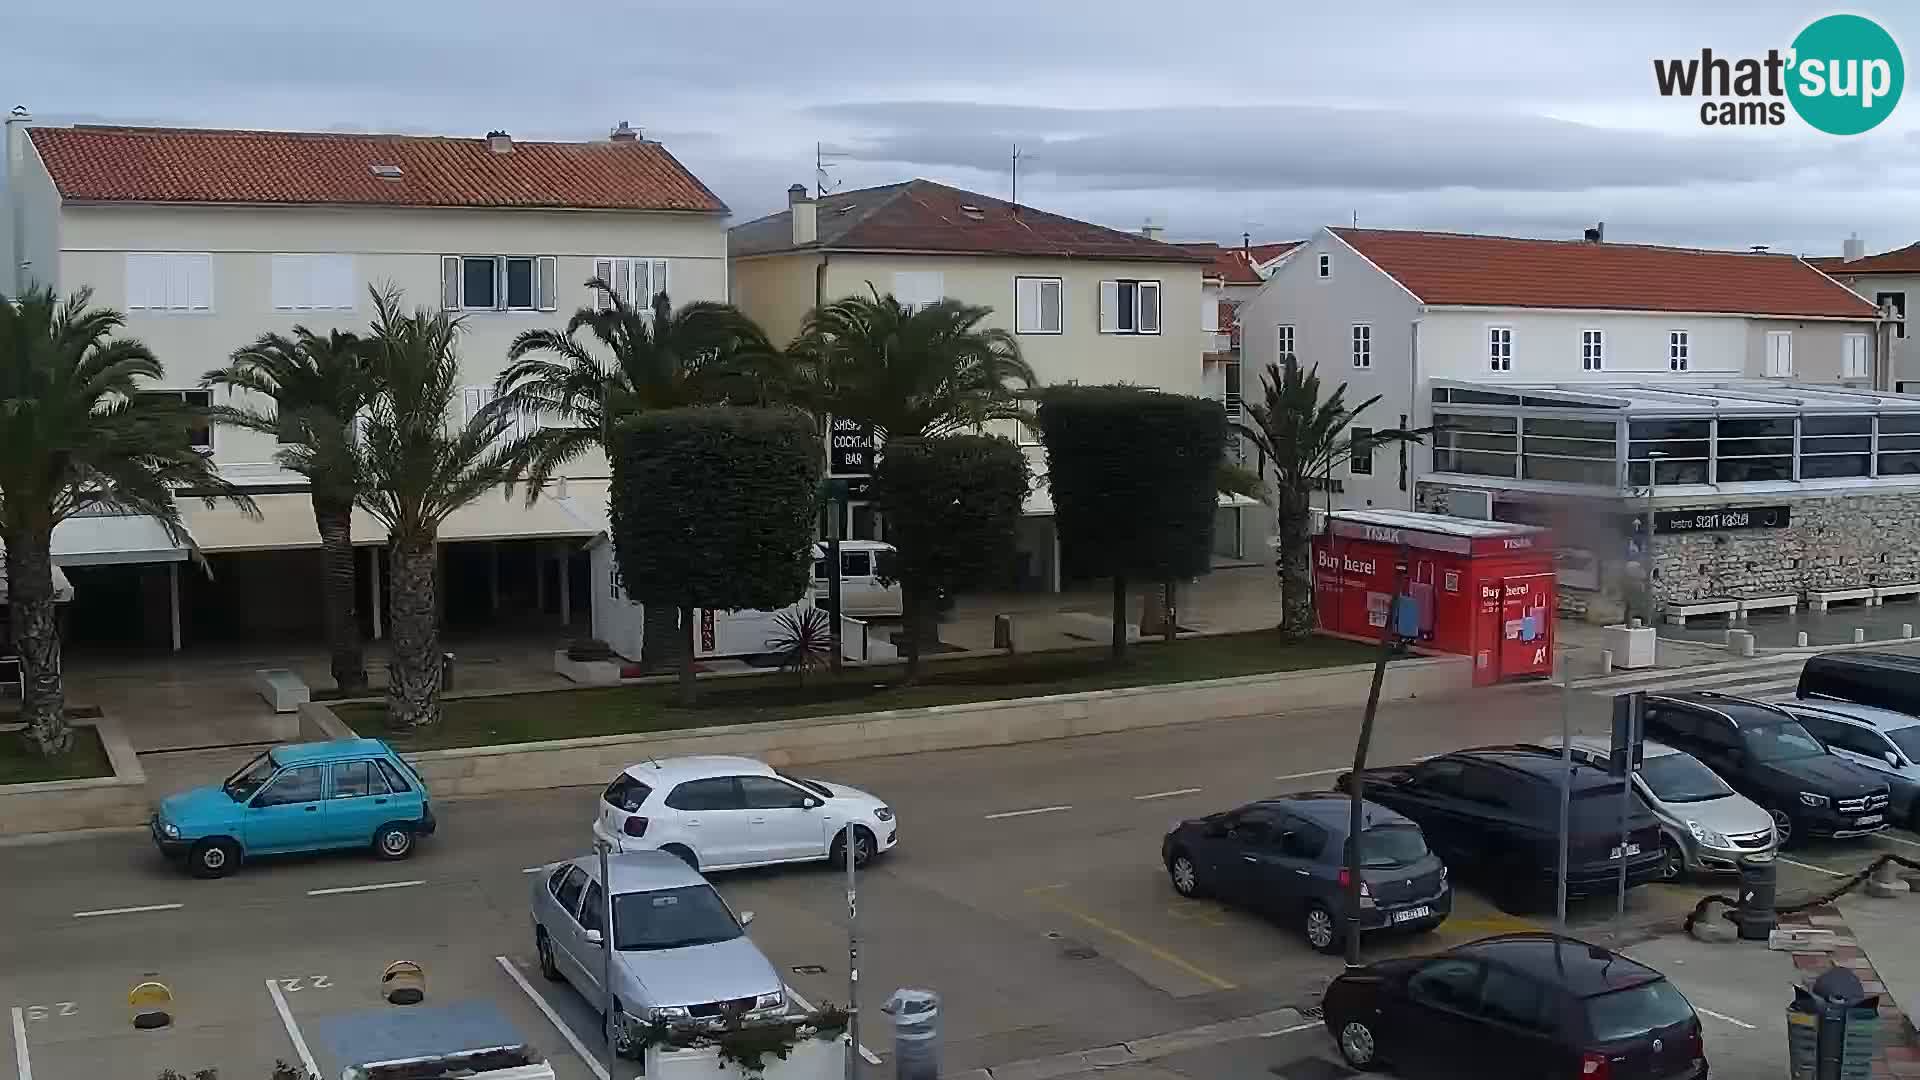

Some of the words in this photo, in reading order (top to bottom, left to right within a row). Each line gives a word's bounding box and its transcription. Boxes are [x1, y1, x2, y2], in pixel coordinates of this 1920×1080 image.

[834, 435, 872, 448] COCKTAIL
[845, 453, 862, 465] BAR
[1670, 519, 1693, 529] bistro
[1319, 550, 1339, 573] Buy
[1344, 554, 1376, 576] here!
[1482, 586, 1500, 599] Buy
[1505, 583, 1529, 597] here!
